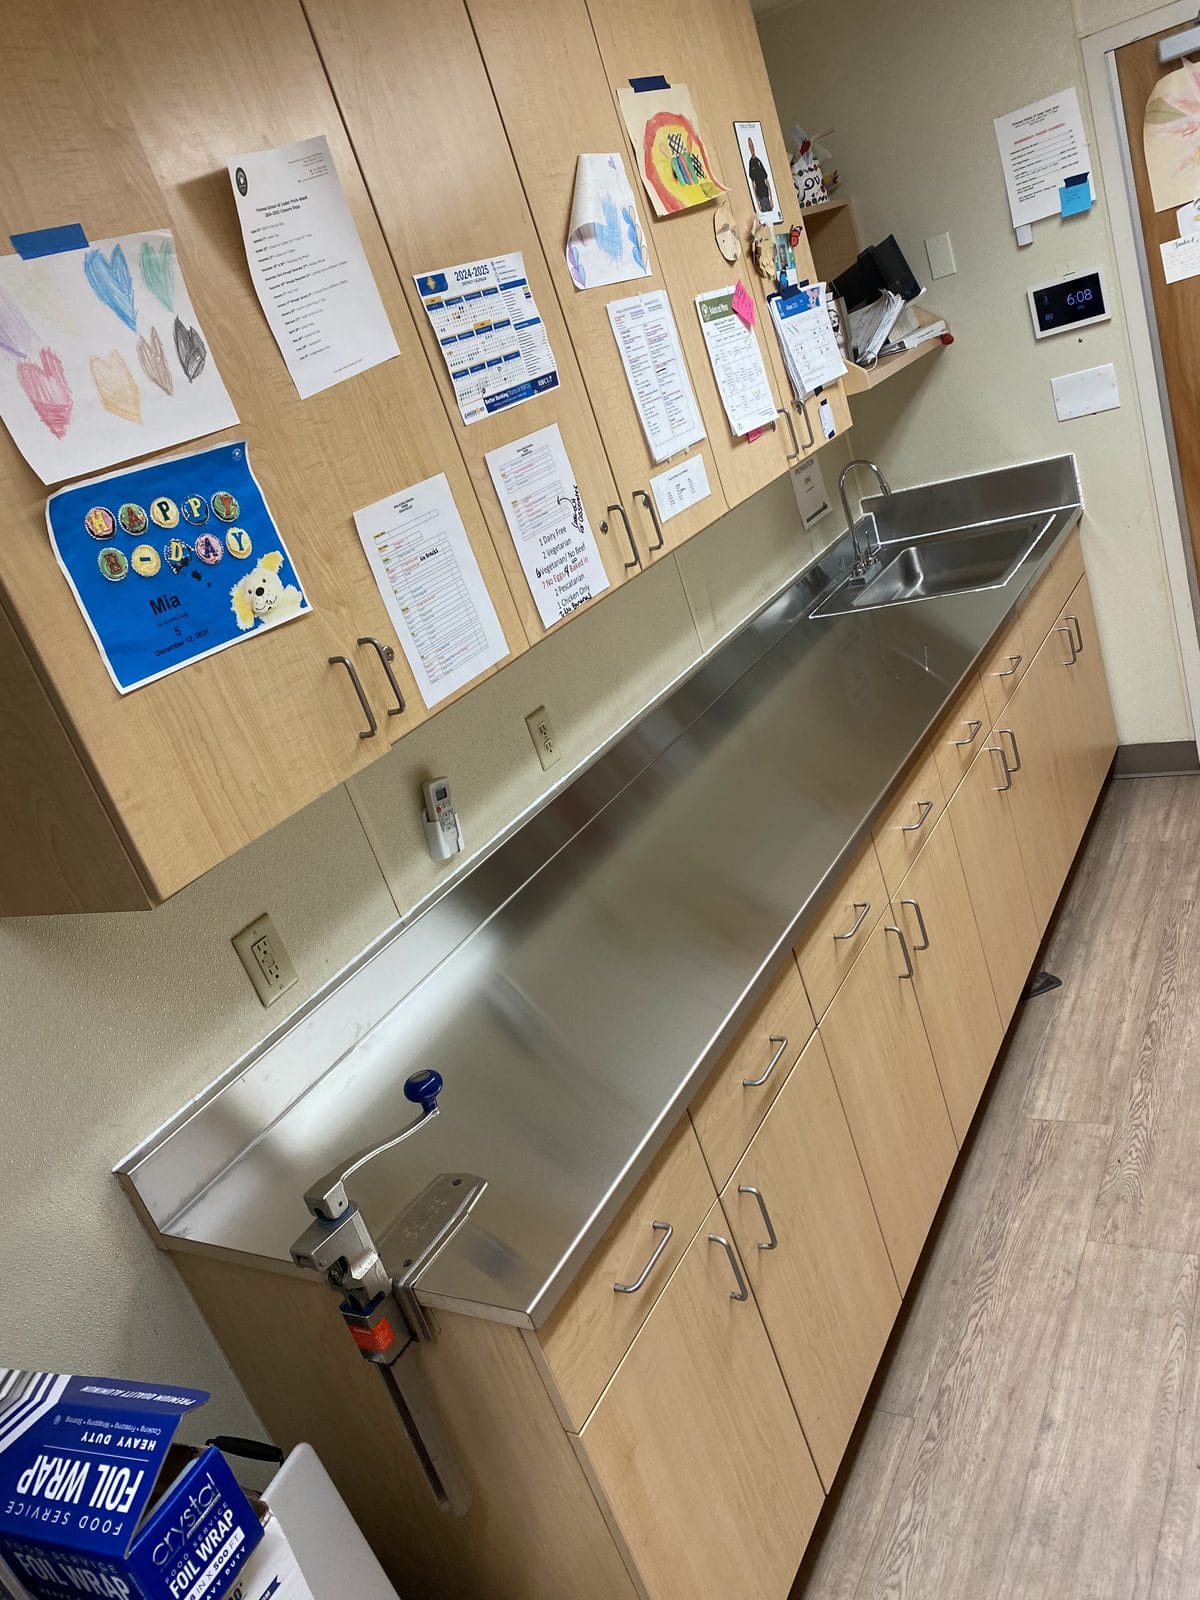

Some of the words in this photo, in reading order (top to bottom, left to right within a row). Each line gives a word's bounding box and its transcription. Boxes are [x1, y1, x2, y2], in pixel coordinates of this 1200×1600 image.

[454, 264, 490, 282] 2024-2025
[1066, 288, 1093, 306] 6:08
[87, 492, 238, 536] HAPPY
[542, 532, 557, 545] Dairy
[555, 526, 568, 537] Free
[101, 530, 250, 578] B-DAY
[546, 538, 572, 557] Vegetarian
[568, 550, 576, 559] No
[574, 542, 586, 555] Beef
[568, 559, 584, 574] Baked
[546, 578, 554, 588] No
[557, 573, 586, 594] Pescatarian
[150, 594, 181, 616] Mia
[561, 590, 580, 607] Chicken
[578, 584, 592, 597] Only
[174, 626, 182, 637] 5
[155, 637, 187, 657] December
[195, 628, 210, 640] 2020
[80, 1385, 121, 1397] ALUMINUM
[120, 1390, 158, 1400] QUALITY
[155, 1394, 197, 1406] PREMIUM
[114, 1422, 137, 1433] Freezing
[140, 1424, 162, 1436] Cooking
[80, 1431, 113, 1446] DUTY
[116, 1436, 158, 1452] HEAVY
[16, 1454, 91, 1505] WRAP
[88, 1463, 145, 1514] FOIL
[5, 1500, 71, 1526] SERVICE
[152, 1471, 221, 1566] crystal
[79, 1515, 124, 1536] FOOD
[192, 1501, 229, 1549] SERVICE
[168, 1558, 201, 1600] FOIL
[195, 1508, 234, 1562] WRAP
[213, 1549, 230, 1571] 500
[224, 1546, 246, 1576] DUTY
[13, 1551, 69, 1587] FOIL
[57, 1562, 131, 1600] WRAP
